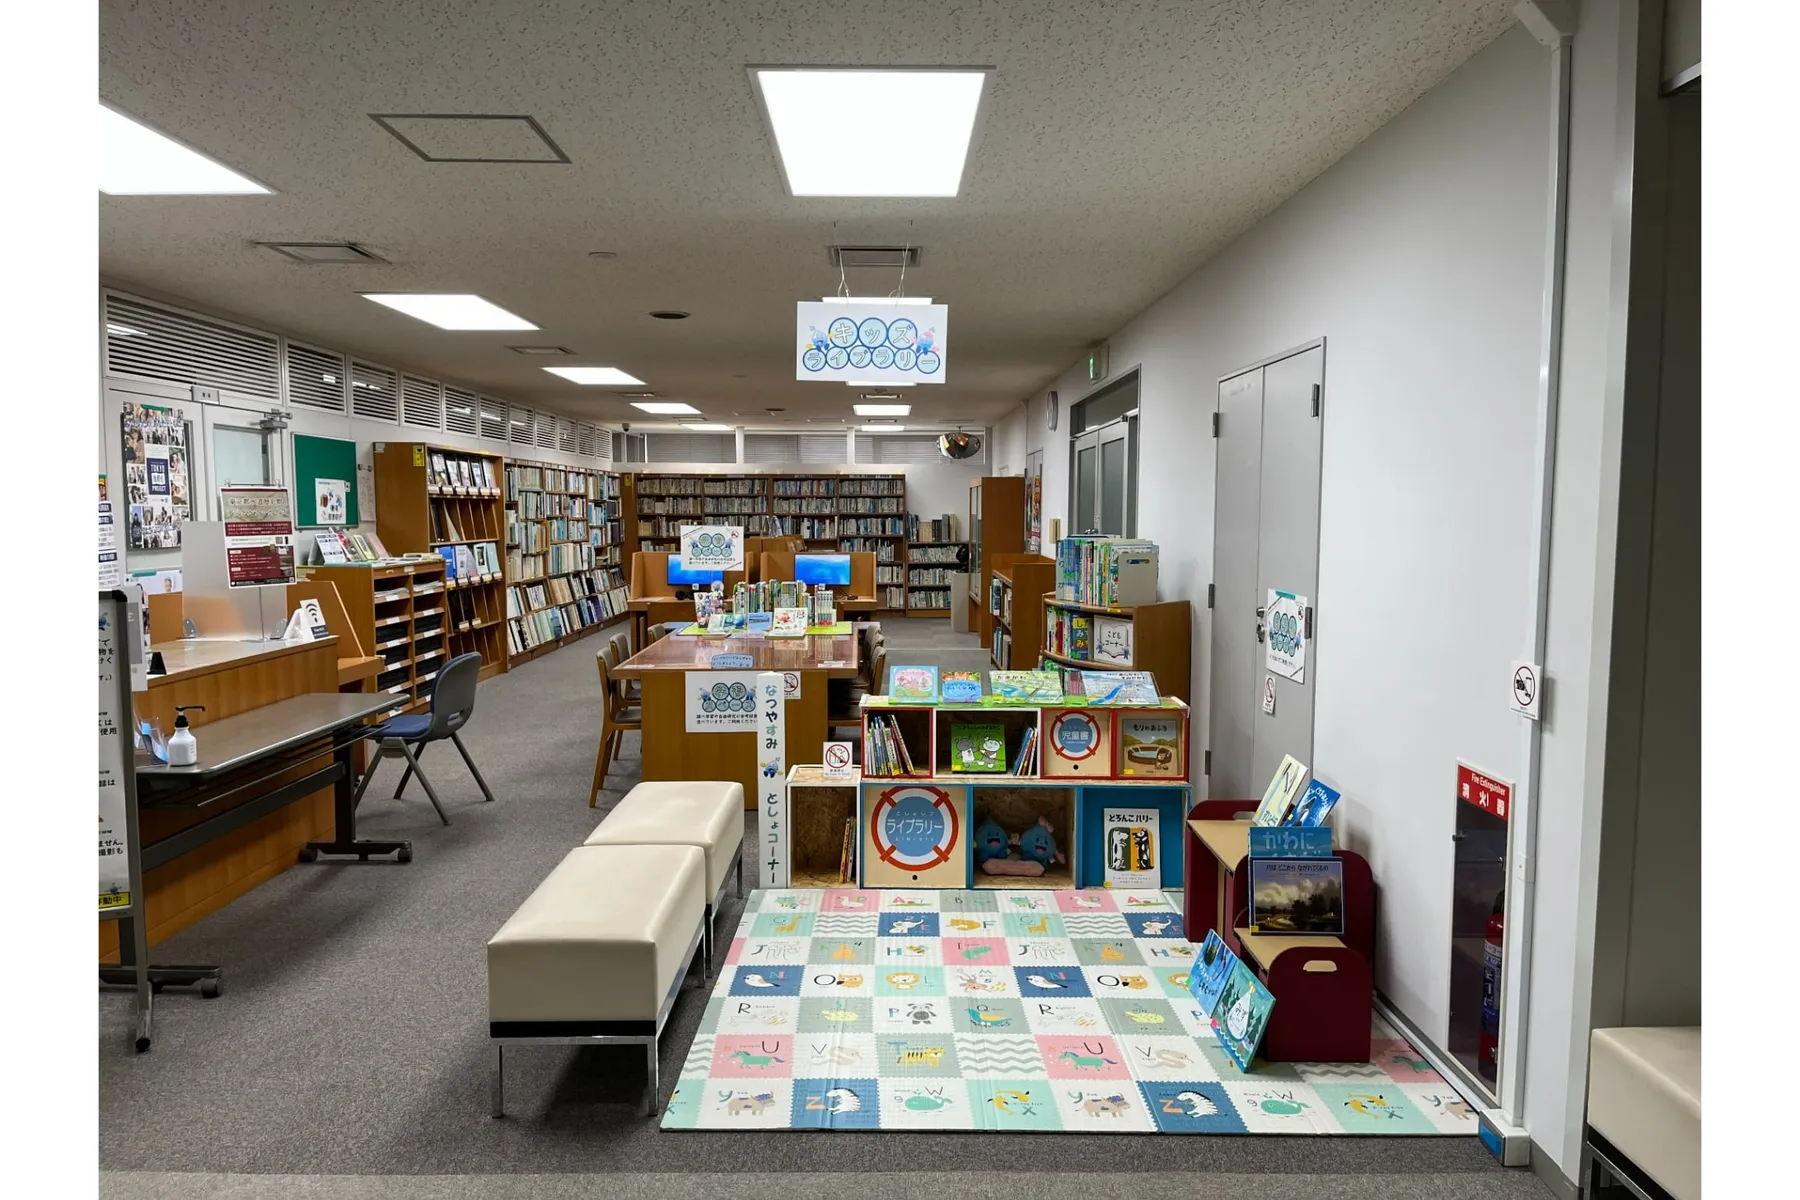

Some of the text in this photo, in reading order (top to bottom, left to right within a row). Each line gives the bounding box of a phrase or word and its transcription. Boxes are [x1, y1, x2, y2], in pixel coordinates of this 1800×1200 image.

[832, 320, 915, 346] キッズ
[806, 348, 937, 371] ライブラリー
[1108, 631, 1121, 639] こども
[765, 684, 779, 749] なつやすみ
[99, 727, 117, 735] 使用
[1133, 724, 1168, 732] もりのおふろ
[1061, 731, 1089, 740] 児童書
[1471, 773, 1506, 796] Fire Extinguisher
[1108, 814, 1153, 822] どろんこハリー
[887, 818, 943, 834] ライブラリー
[767, 793, 780, 884] としょコーナー
[1263, 831, 1315, 850] かわに
[99, 895, 122, 905] 動中
[813, 974, 836, 986] O
[1096, 974, 1120, 987] O
[738, 1003, 751, 1014] R
[1038, 1004, 1054, 1015] R
[762, 1041, 779, 1053] U
[811, 1043, 828, 1054] V
[1084, 1042, 1104, 1055] U
[925, 1086, 943, 1096] W
